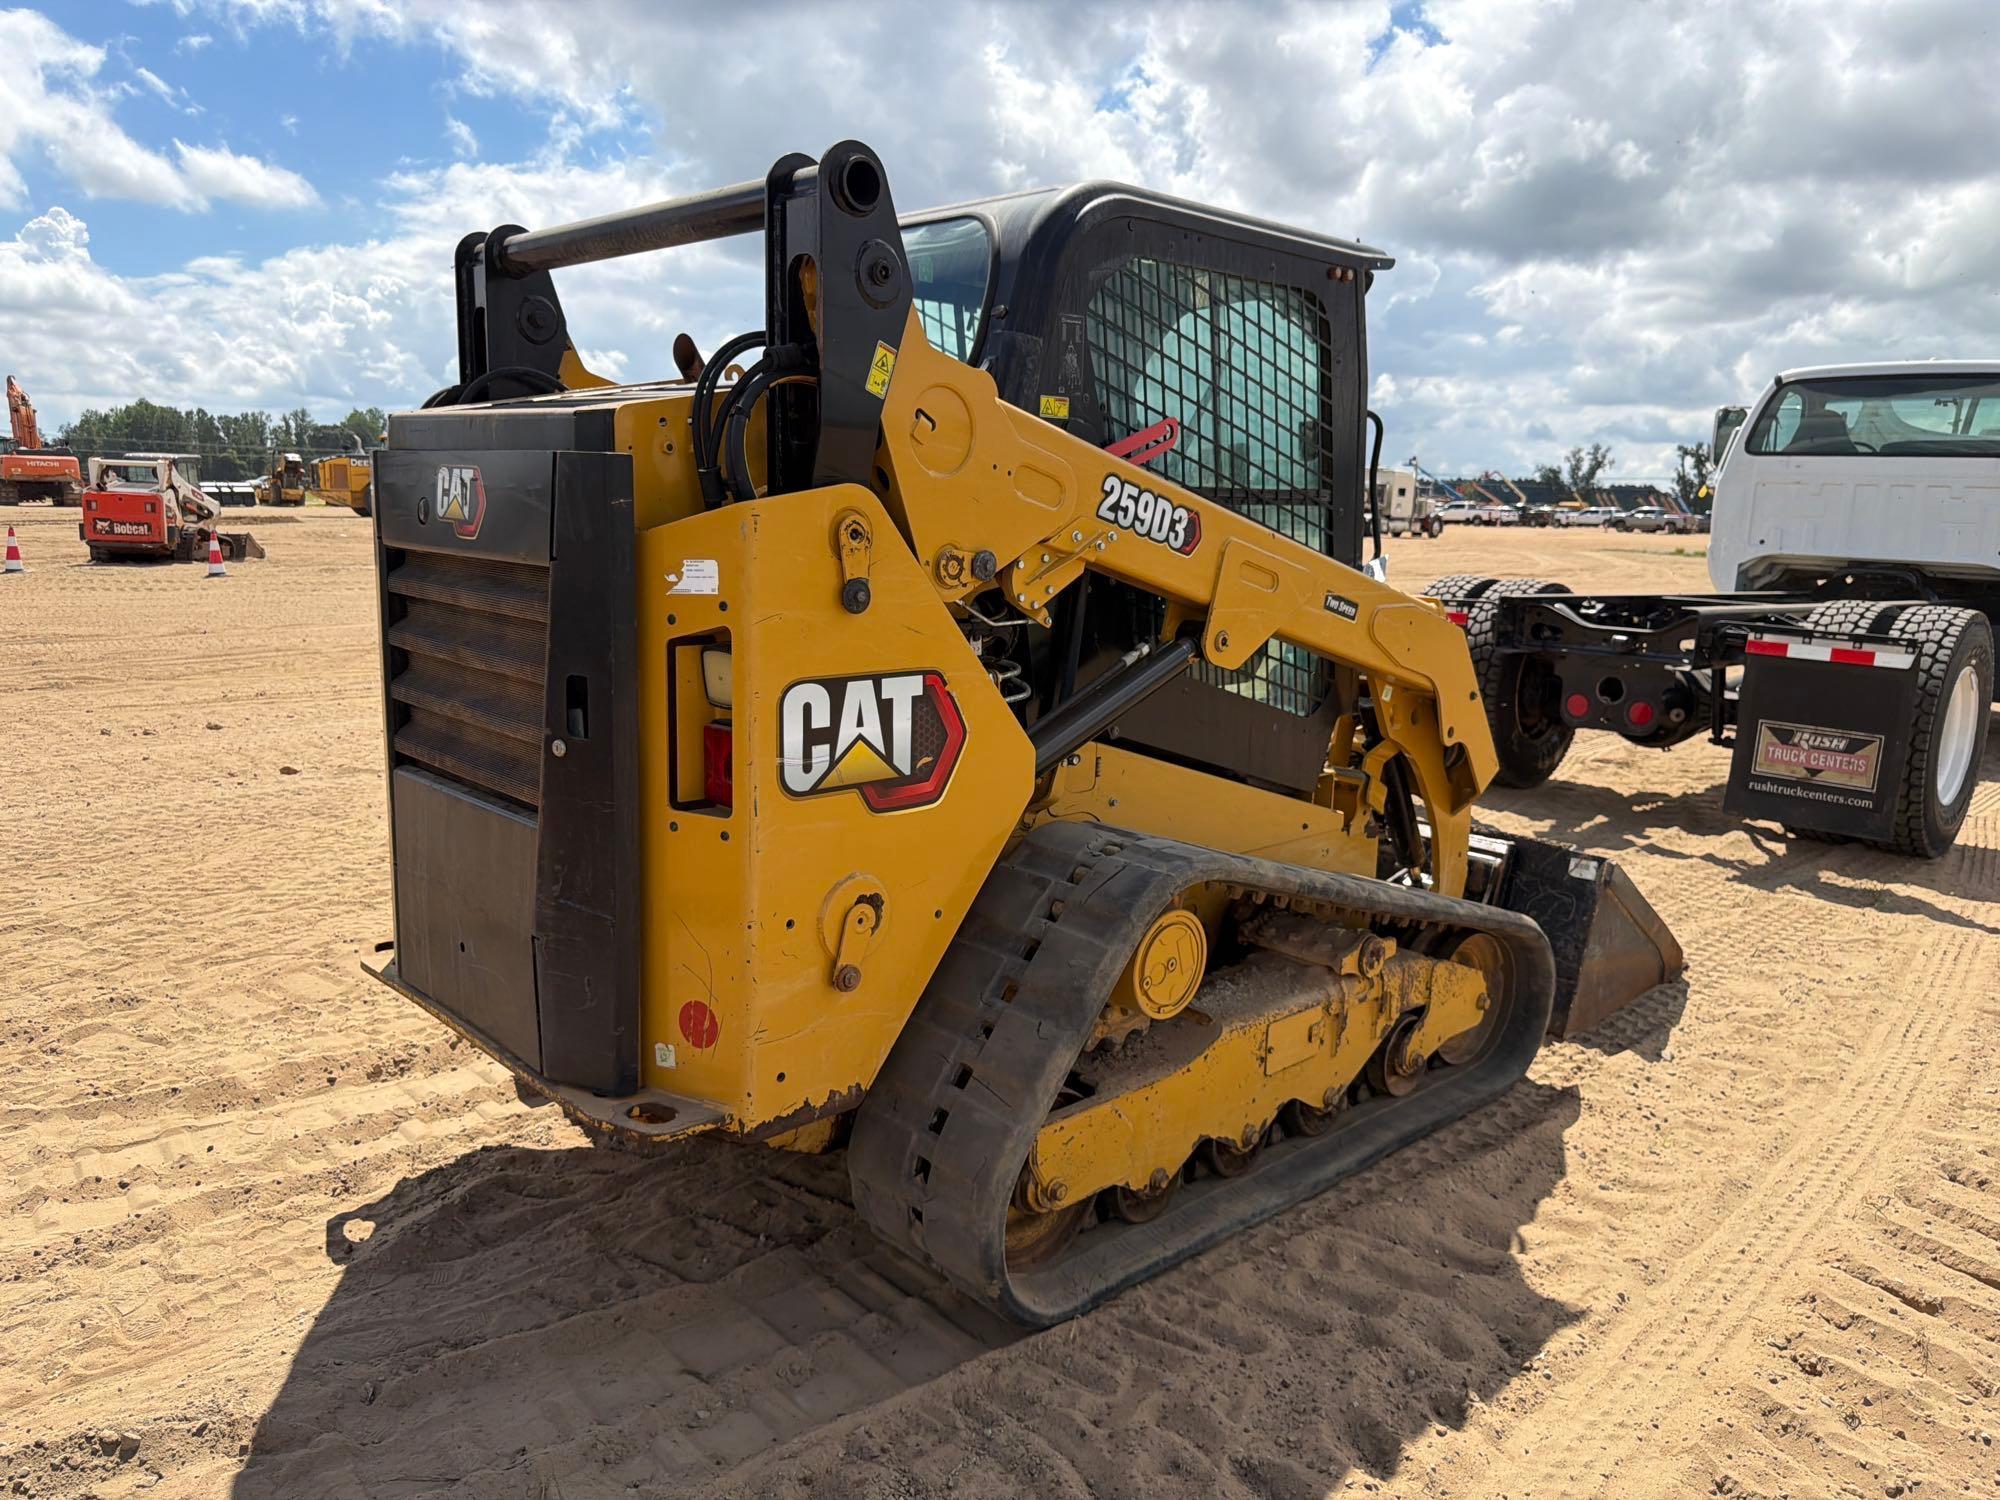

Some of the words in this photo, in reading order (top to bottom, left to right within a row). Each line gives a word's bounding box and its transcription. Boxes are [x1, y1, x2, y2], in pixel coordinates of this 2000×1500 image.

[26, 460, 60, 468] HITACHI
[437, 466, 474, 520] CAT
[1097, 475, 1189, 549] 259D3
[113, 522, 149, 535] Bobcat
[783, 674, 924, 793] CAT
[1767, 746, 1807, 764] TRUCK
[1810, 752, 1868, 773] CENTERS
[1749, 779, 1874, 810] rushtruckcenters.com
